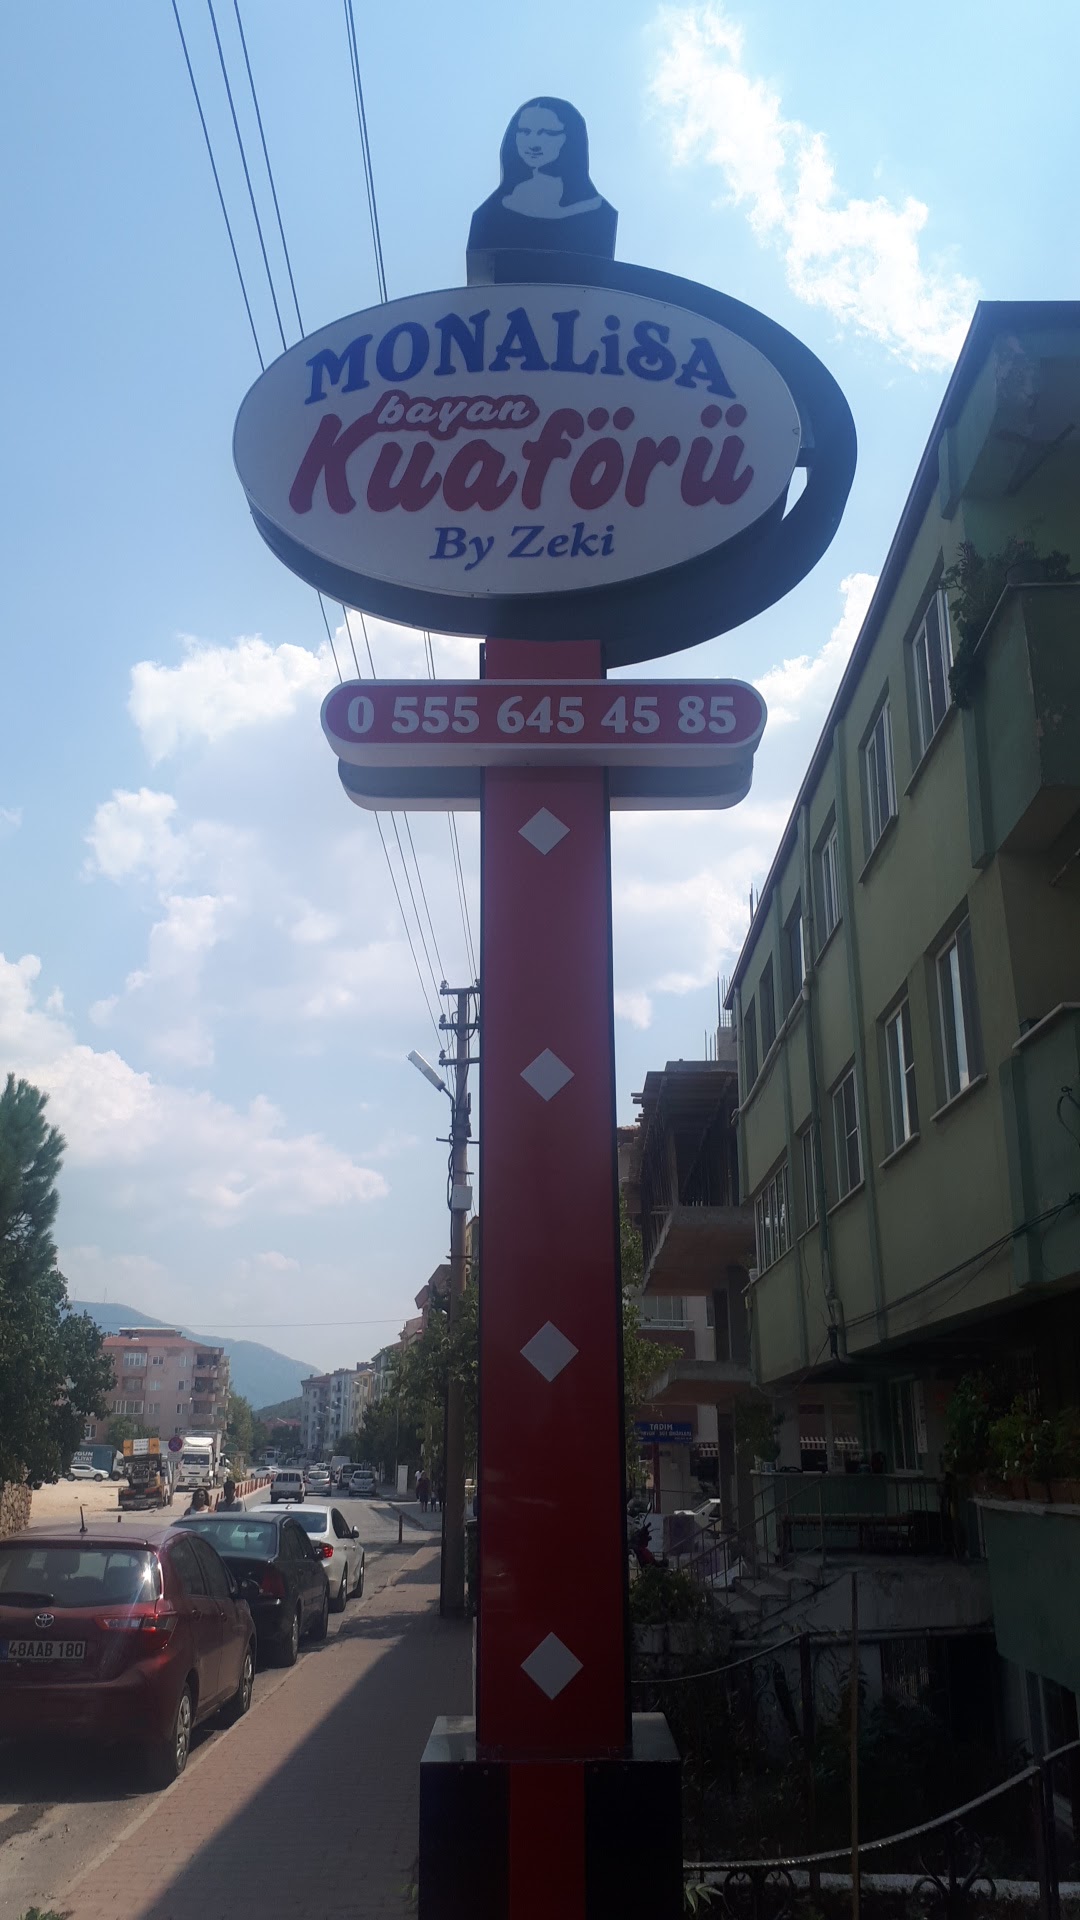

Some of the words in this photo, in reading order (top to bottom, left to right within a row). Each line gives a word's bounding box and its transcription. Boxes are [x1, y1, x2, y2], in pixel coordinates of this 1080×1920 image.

[377, 395, 532, 433] bayan
[288, 403, 755, 514] Kuaförü
[429, 526, 494, 571] By
[507, 522, 616, 560] Zeki
[347, 696, 375, 734] 0
[391, 696, 479, 734] 555
[496, 695, 586, 734] 645
[601, 696, 661, 734] 45
[677, 695, 738, 734] 85
[58, 1642, 84, 1658] 180
